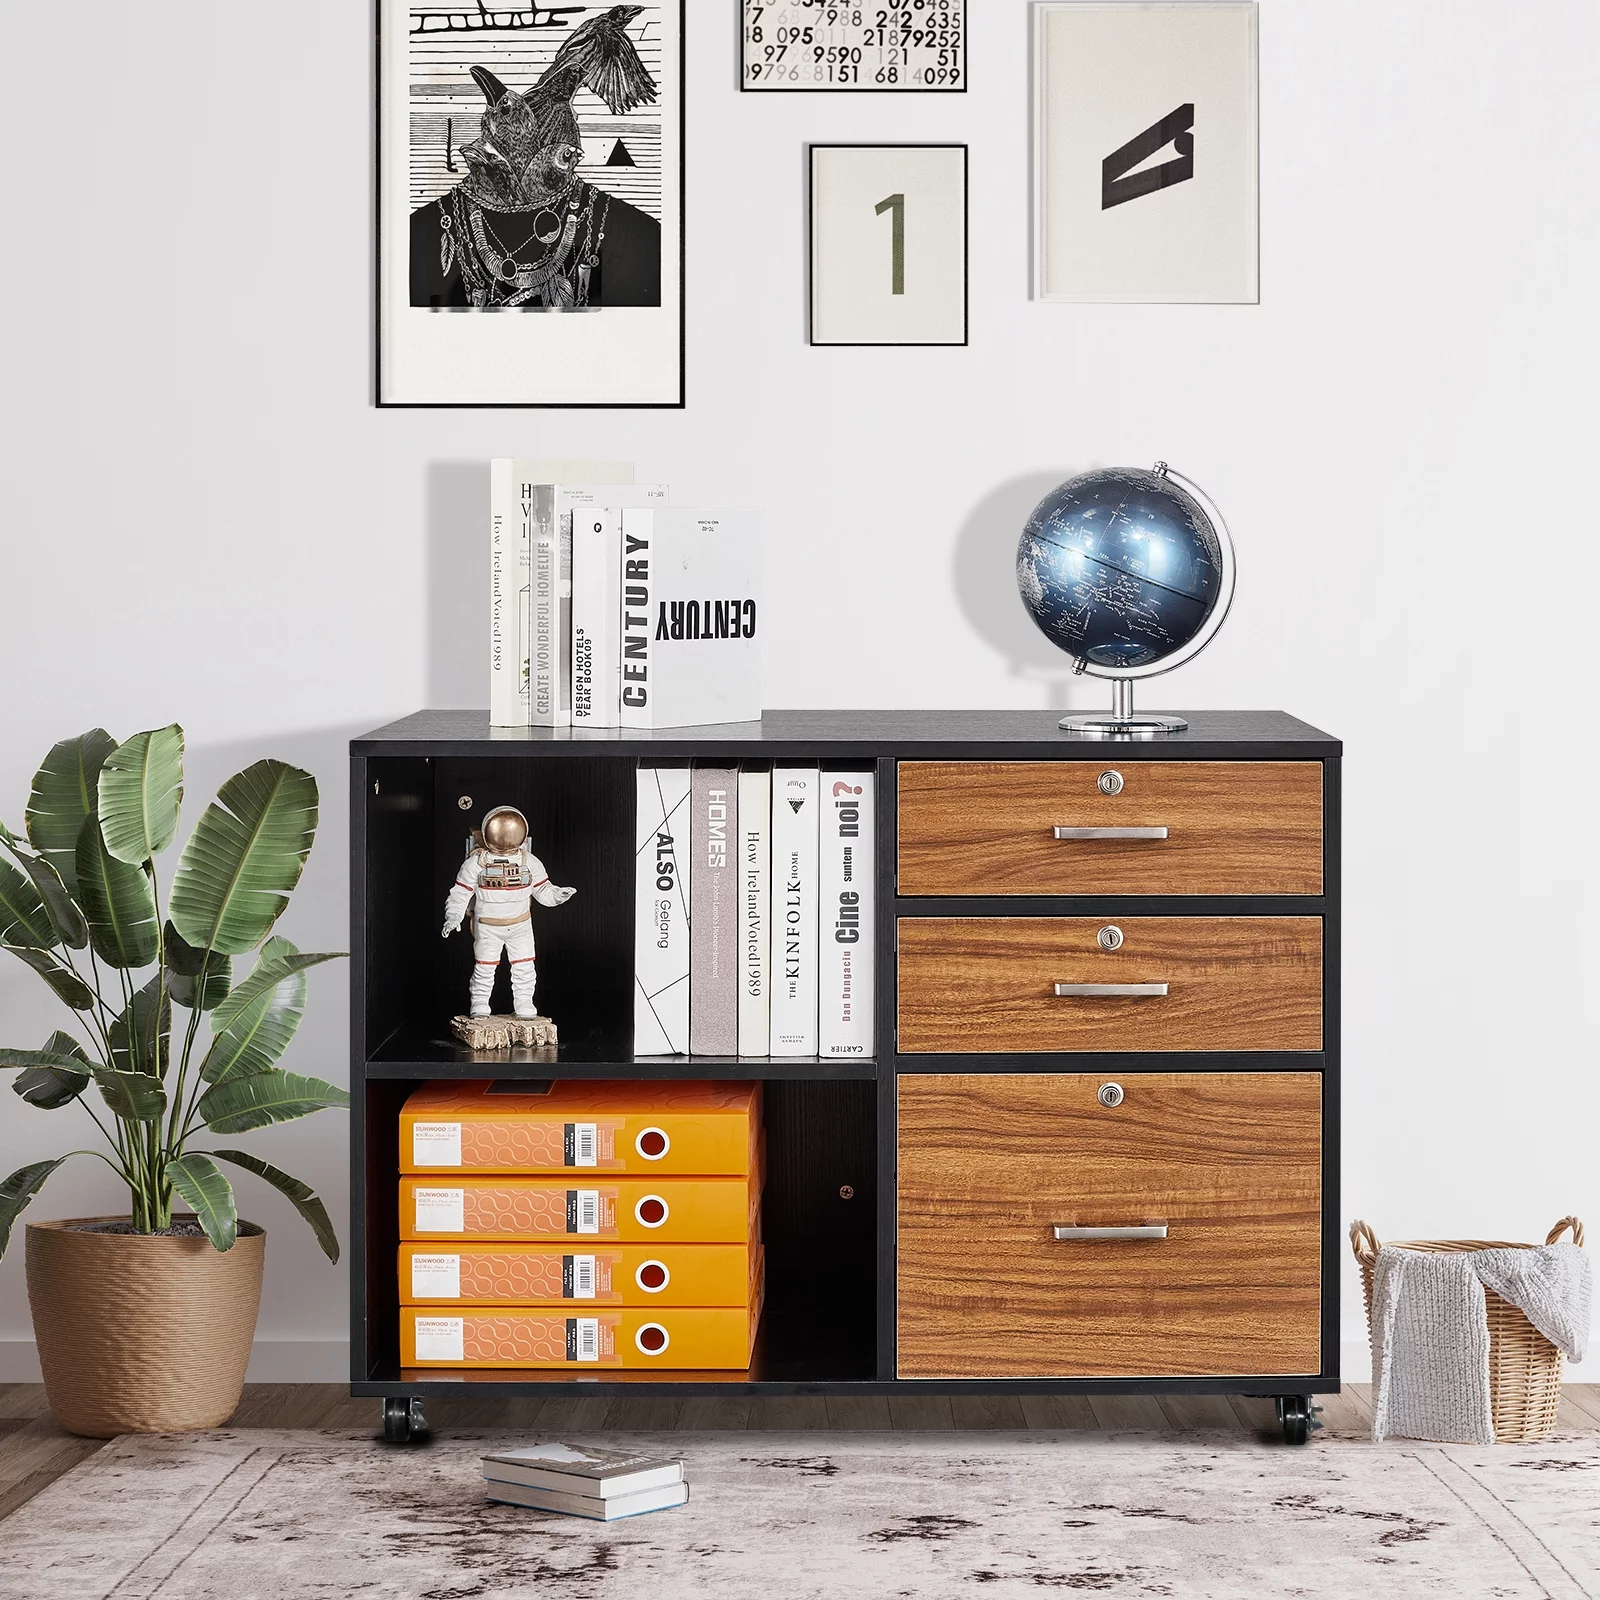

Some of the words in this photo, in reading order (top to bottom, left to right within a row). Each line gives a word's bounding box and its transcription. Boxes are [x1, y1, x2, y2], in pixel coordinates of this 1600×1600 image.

[874, 193, 905, 295] 1
[494, 515, 502, 545] How
[537, 542, 549, 597] HOMELIFE
[537, 600, 549, 672] WONDERFUL
[622, 534, 649, 707] CENTURY
[655, 599, 756, 641] CENTURY
[584, 638, 592, 684] BOOK09
[537, 674, 549, 715] CREATE
[575, 676, 584, 717] DESIGN
[583, 688, 592, 717] YEAR
[708, 789, 727, 868] HOMES
[747, 831, 760, 864] How
[656, 832, 674, 892] ALSO
[791, 851, 799, 879] HOME
[843, 846, 853, 882] suntem
[657, 899, 671, 949] Gelang
[786, 880, 801, 979] KINFOLK
[835, 891, 860, 944] Cine
[842, 951, 851, 999] Dungaciu
[842, 1003, 851, 1022] Dan
[831, 1045, 863, 1053] CARTIER
